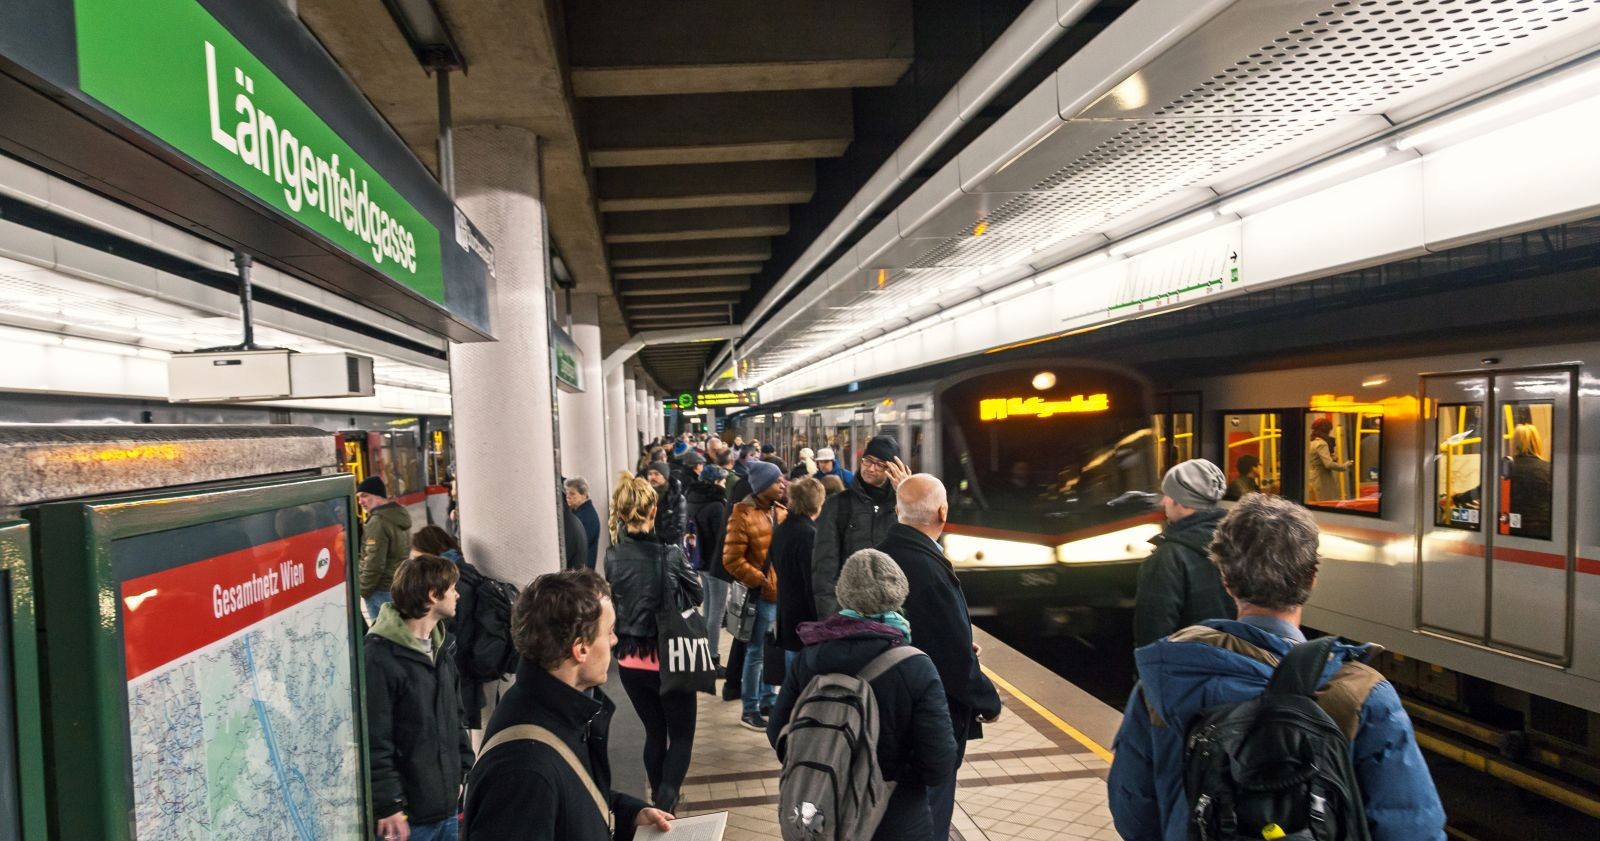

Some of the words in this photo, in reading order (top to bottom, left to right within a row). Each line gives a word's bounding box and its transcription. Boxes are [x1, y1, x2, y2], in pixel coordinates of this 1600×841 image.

[204, 40, 417, 274] Längenfeldgasse
[213, 568, 279, 618] Gesamtnetz
[280, 560, 304, 591] Wien
